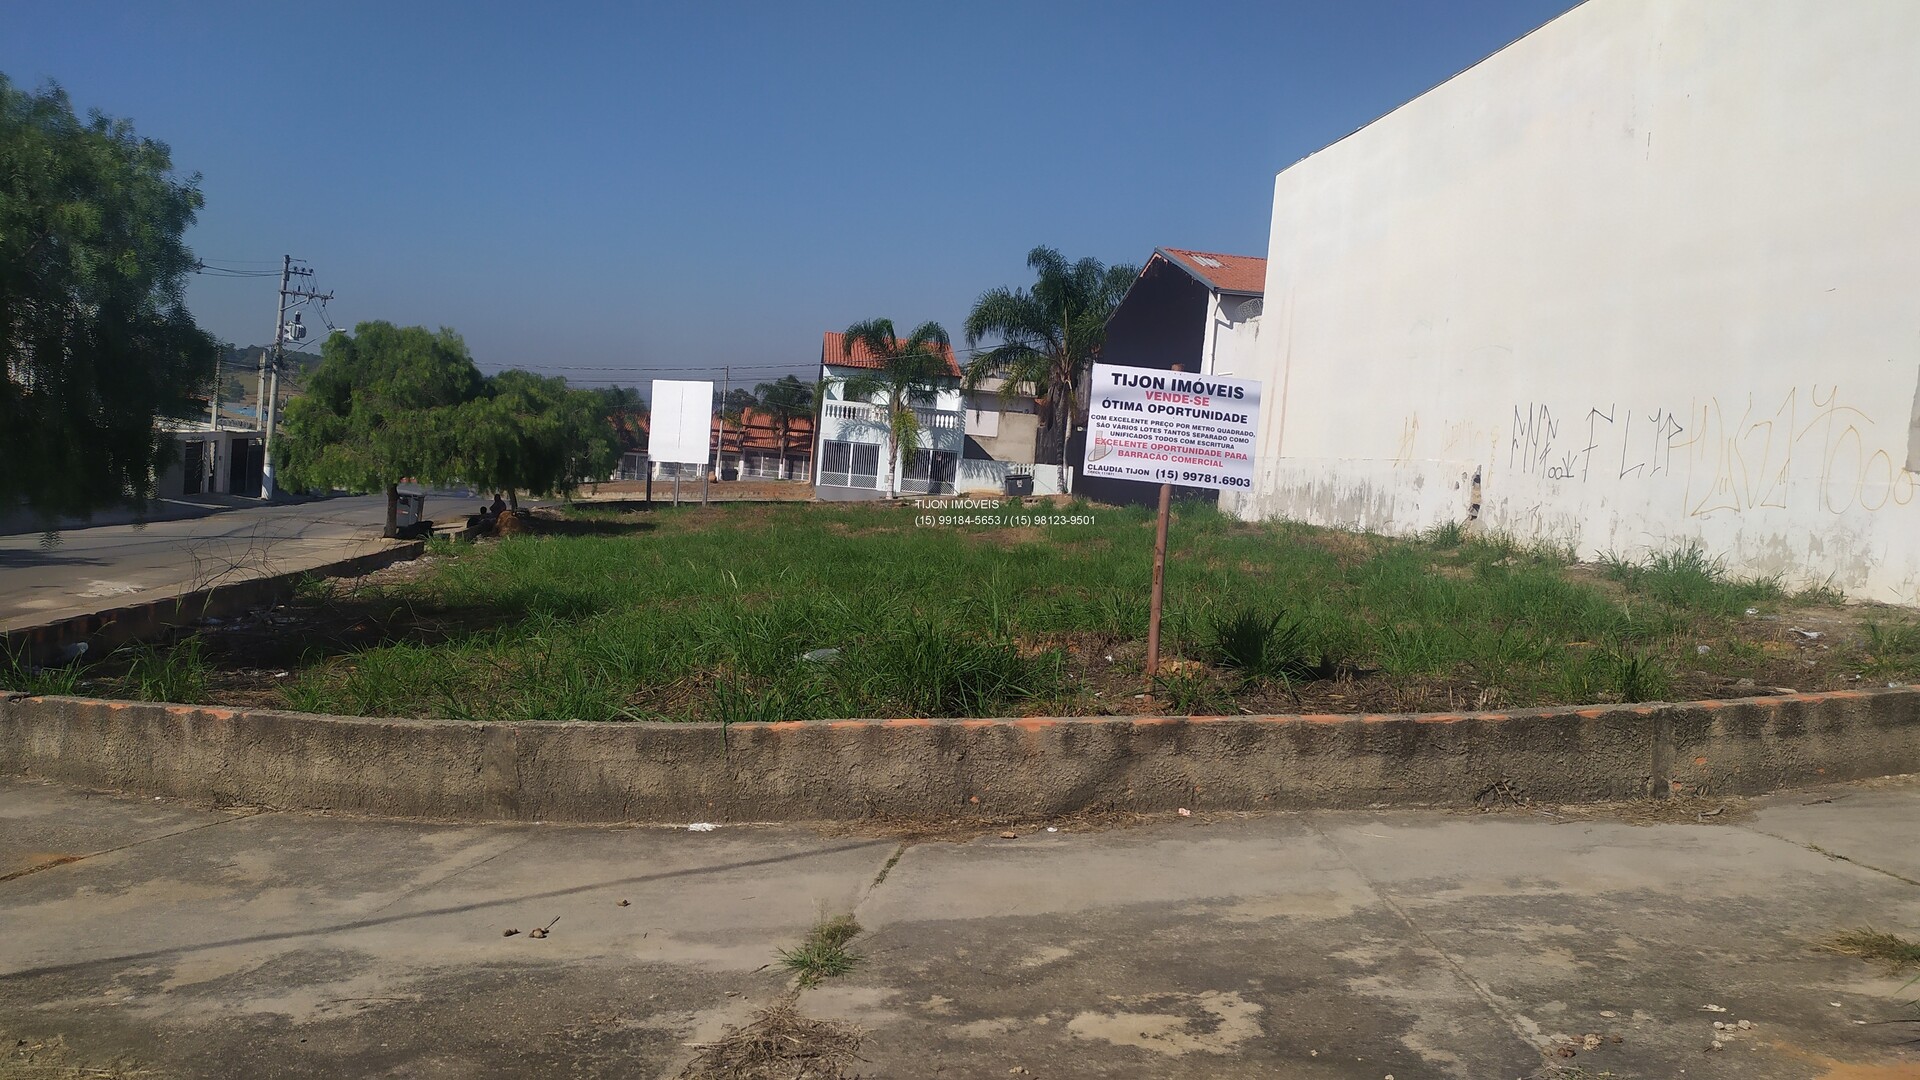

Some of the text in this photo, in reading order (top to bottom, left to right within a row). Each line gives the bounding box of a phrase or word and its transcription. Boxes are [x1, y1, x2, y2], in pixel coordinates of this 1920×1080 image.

[1112, 373, 1244, 399] TIJON IMÓVEIS
[1146, 391, 1210, 406] VENDE-SE
[1102, 397, 1248, 423] ÓTIMA OPORTUNIDADE
[1109, 416, 1148, 425] EXCELENTE
[1151, 420, 1174, 428] PREÇO
[1192, 424, 1215, 432] METRO
[1217, 428, 1256, 437] QUADRADO,
[1112, 423, 1138, 431] VÁRIOS
[1164, 429, 1190, 437] TANTOS
[1192, 432, 1227, 441] SEPARADO
[1095, 438, 1247, 460] EXCELENTE OPORTUNIDADE PARA
[1110, 431, 1152, 440] UNIFICADOS
[1197, 439, 1234, 449] ESCRITURA
[1118, 450, 1223, 467] BARRACÃO COMERCIAL
[1088, 464, 1123, 473] CLAUDIA
[1125, 468, 1150, 476] TIJON
[1155, 469, 1178, 481] (15)
[1183, 472, 1250, 487] 99781.6903
